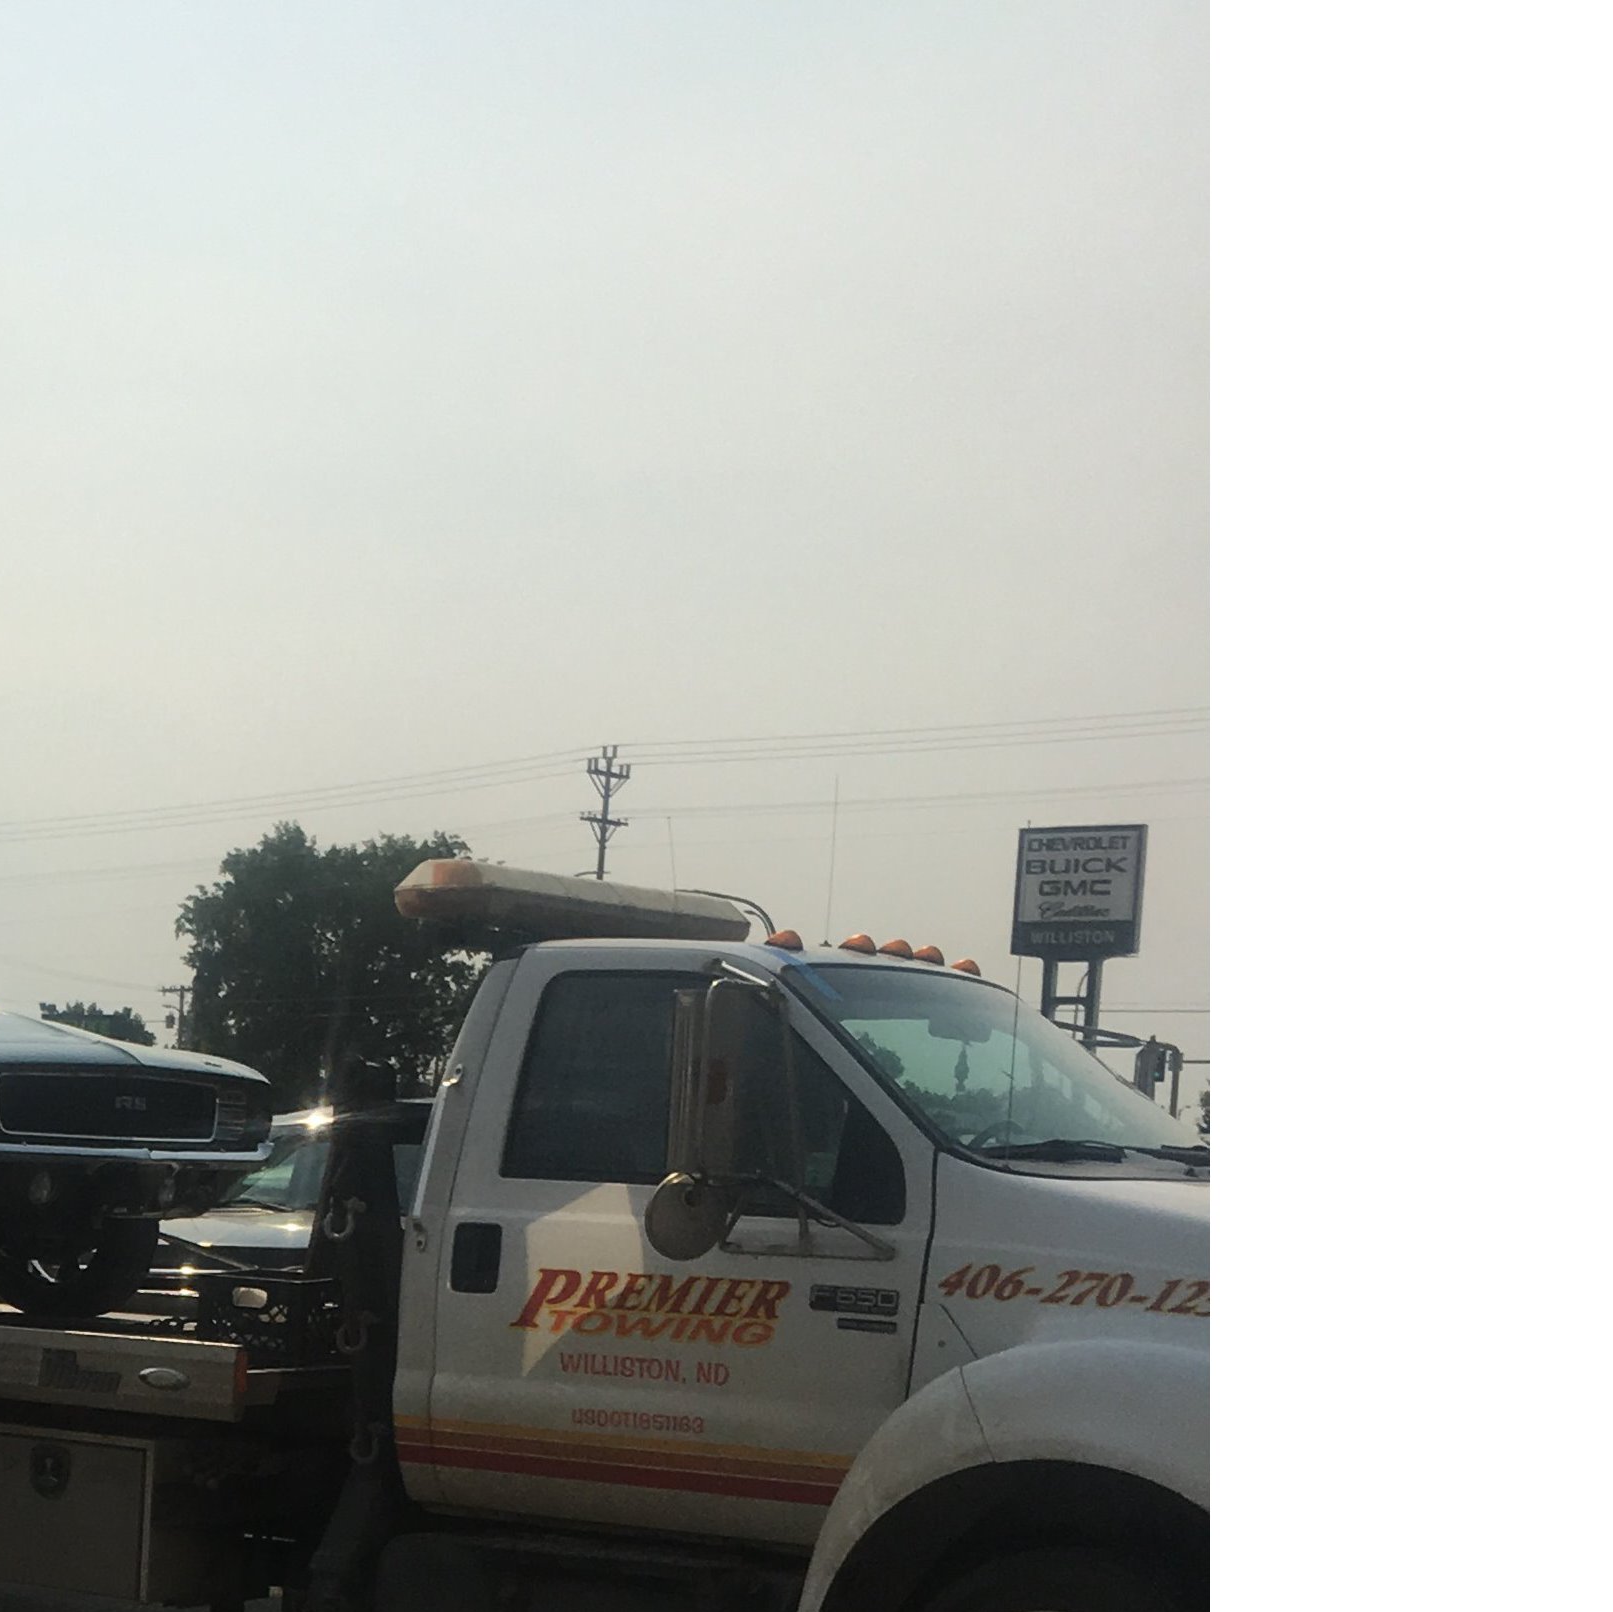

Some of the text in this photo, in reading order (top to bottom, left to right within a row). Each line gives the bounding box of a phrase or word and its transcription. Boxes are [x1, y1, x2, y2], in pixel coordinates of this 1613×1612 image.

[1027, 835, 1131, 852] CHEVROLET
[1025, 857, 1128, 875] BUICK
[1038, 879, 1112, 897] GMC
[1030, 930, 1115, 945] WILLISTON
[509, 1268, 792, 1329] PREMIER
[938, 1261, 1210, 1318] 406-270-12
[548, 1309, 777, 1347] TOWING
[559, 1352, 730, 1387] WILLISTON, ND
